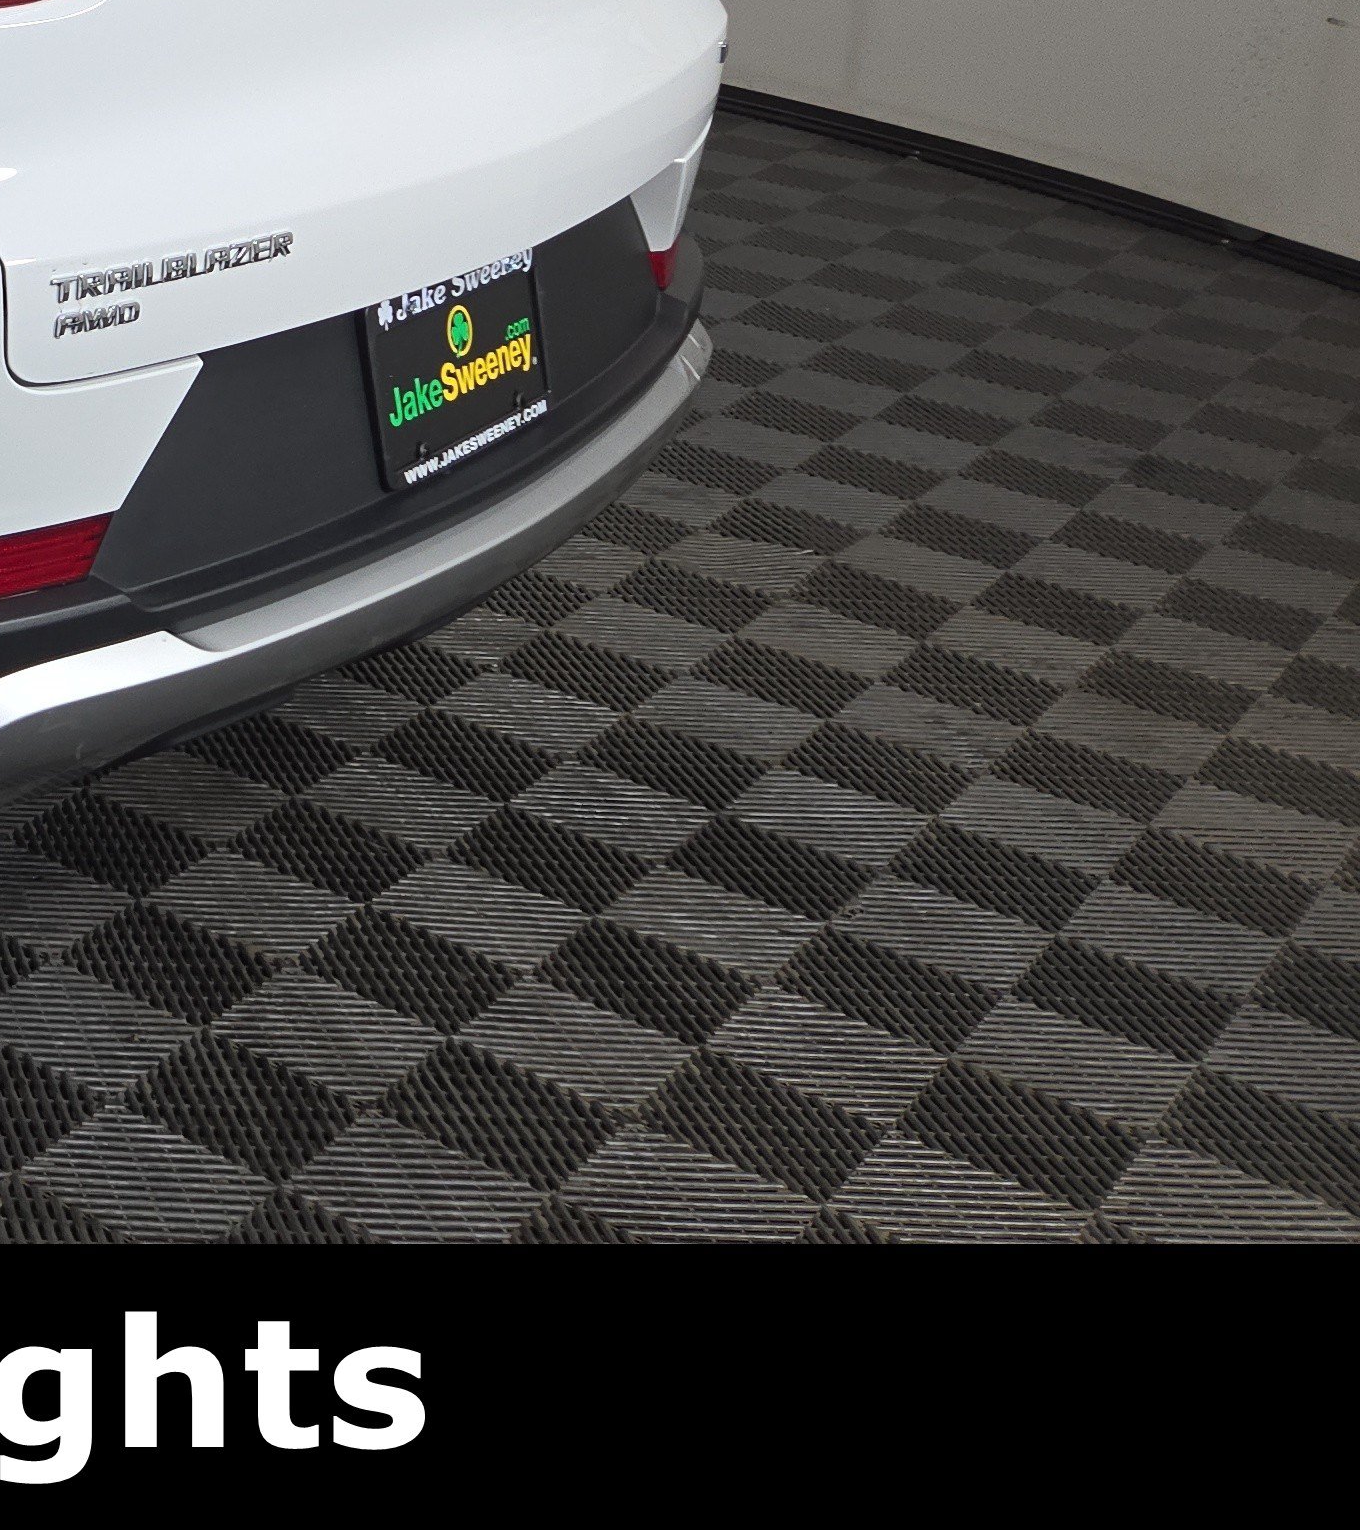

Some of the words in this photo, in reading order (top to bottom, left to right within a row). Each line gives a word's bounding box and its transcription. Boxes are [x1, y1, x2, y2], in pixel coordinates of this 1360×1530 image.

[50, 231, 293, 303] TRAILBLAZER
[53, 301, 140, 339] AWD
[396, 284, 446, 320] Jake
[404, 400, 548, 484] WWW.JAKESWEENEY.COM
